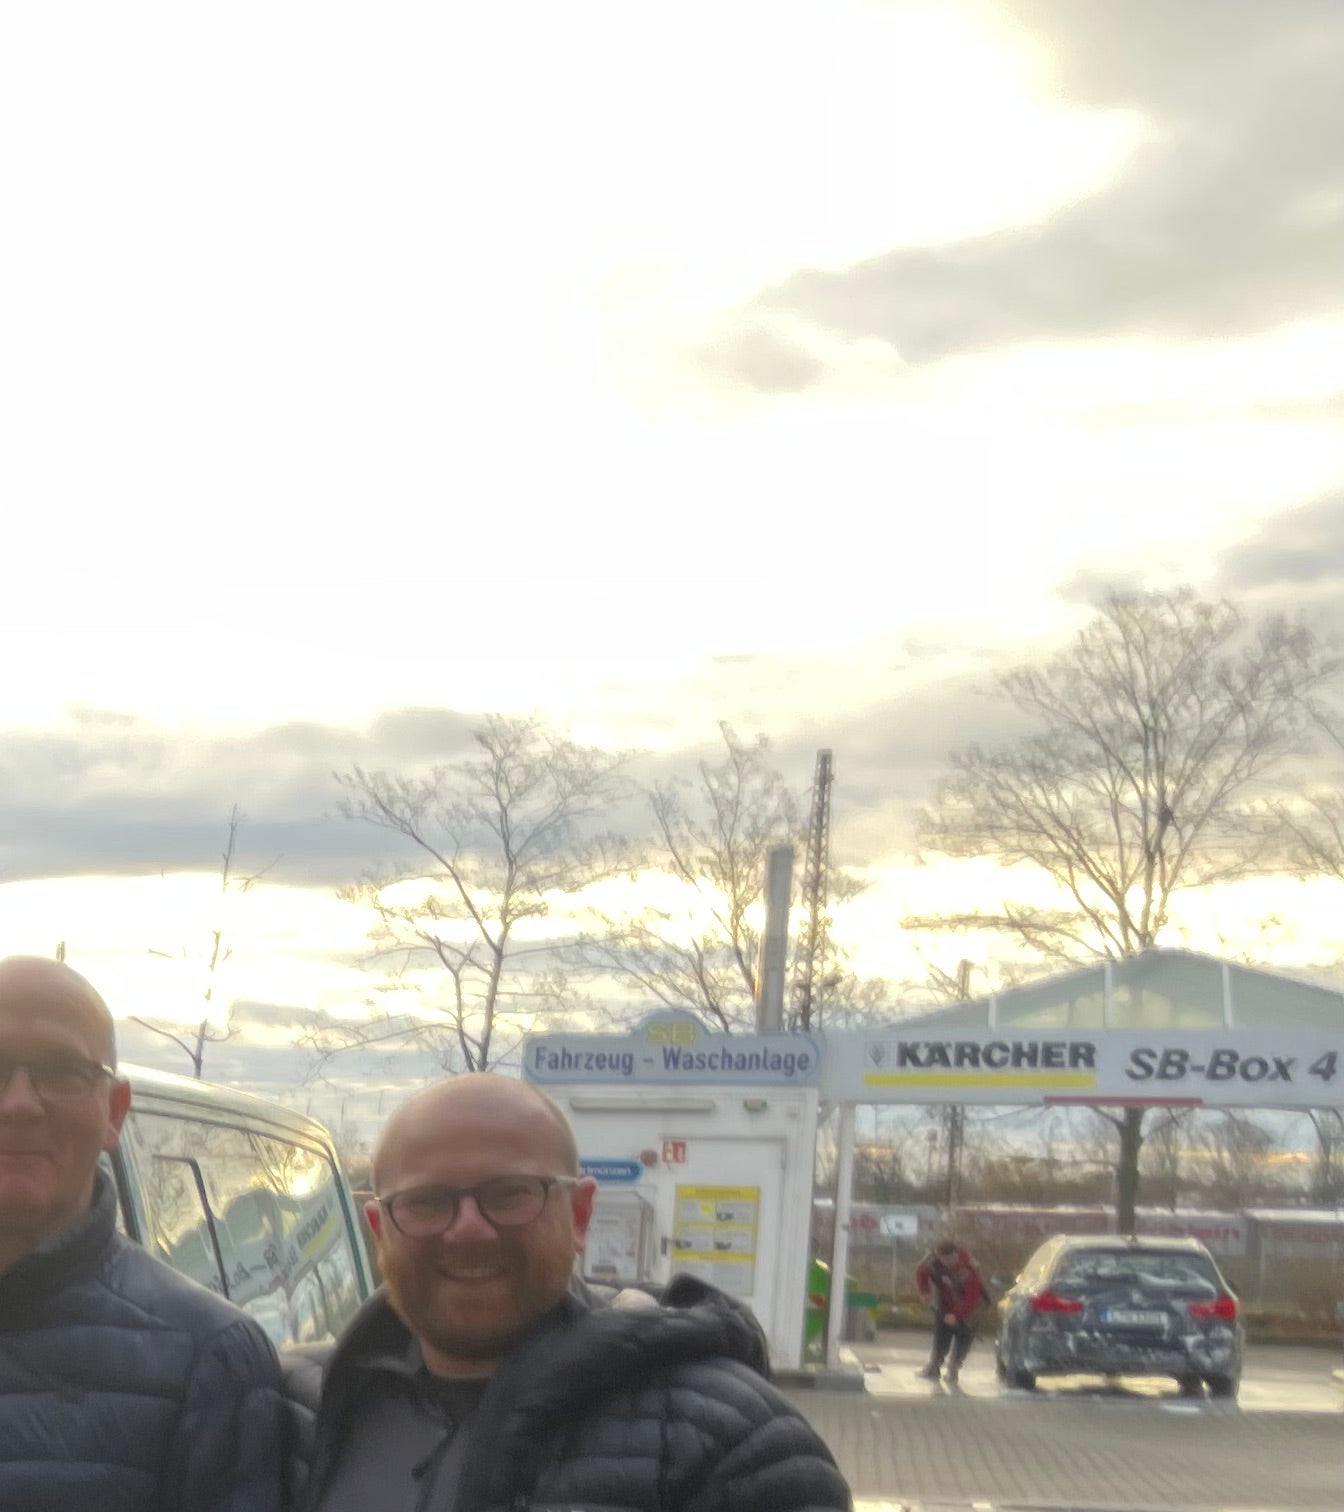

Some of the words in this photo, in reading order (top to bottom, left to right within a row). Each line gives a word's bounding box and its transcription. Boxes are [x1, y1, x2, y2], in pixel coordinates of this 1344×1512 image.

[534, 1047, 634, 1077] Fahrzeug
[662, 1047, 810, 1077] Waschanlage
[895, 1041, 1098, 1069] KÄRCHER
[1125, 1048, 1298, 1082] SB-Box
[1307, 1050, 1338, 1082] 4
